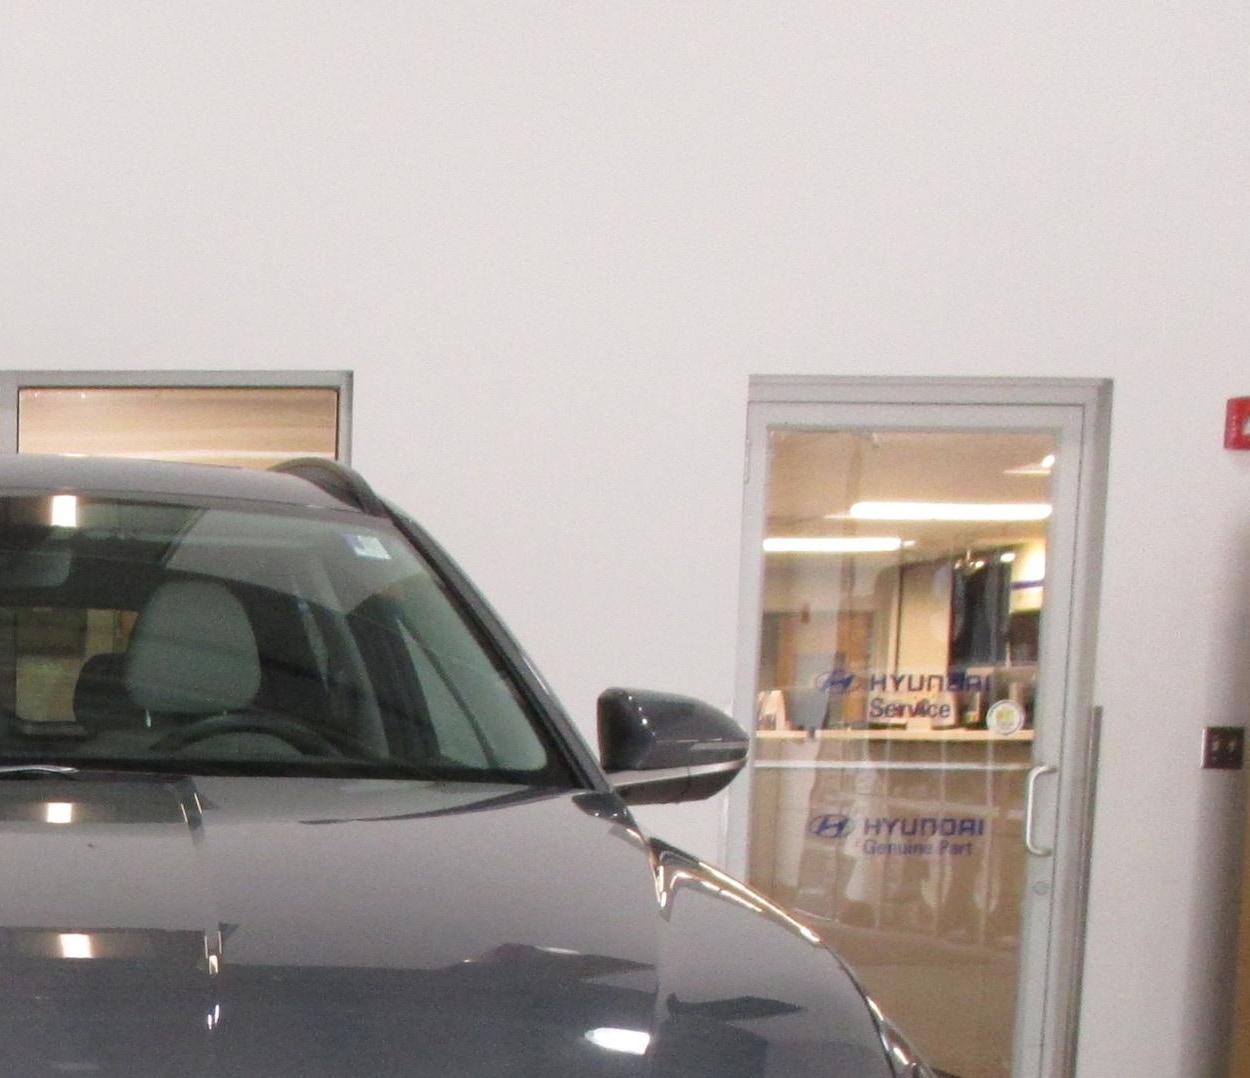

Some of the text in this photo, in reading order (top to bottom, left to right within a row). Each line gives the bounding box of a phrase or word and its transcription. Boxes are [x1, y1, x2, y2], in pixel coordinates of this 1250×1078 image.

[869, 673, 991, 692] HYUNDAI
[869, 697, 951, 718] Service
[863, 817, 985, 836] HYUNDAI
[862, 839, 973, 856] Genuine Part
